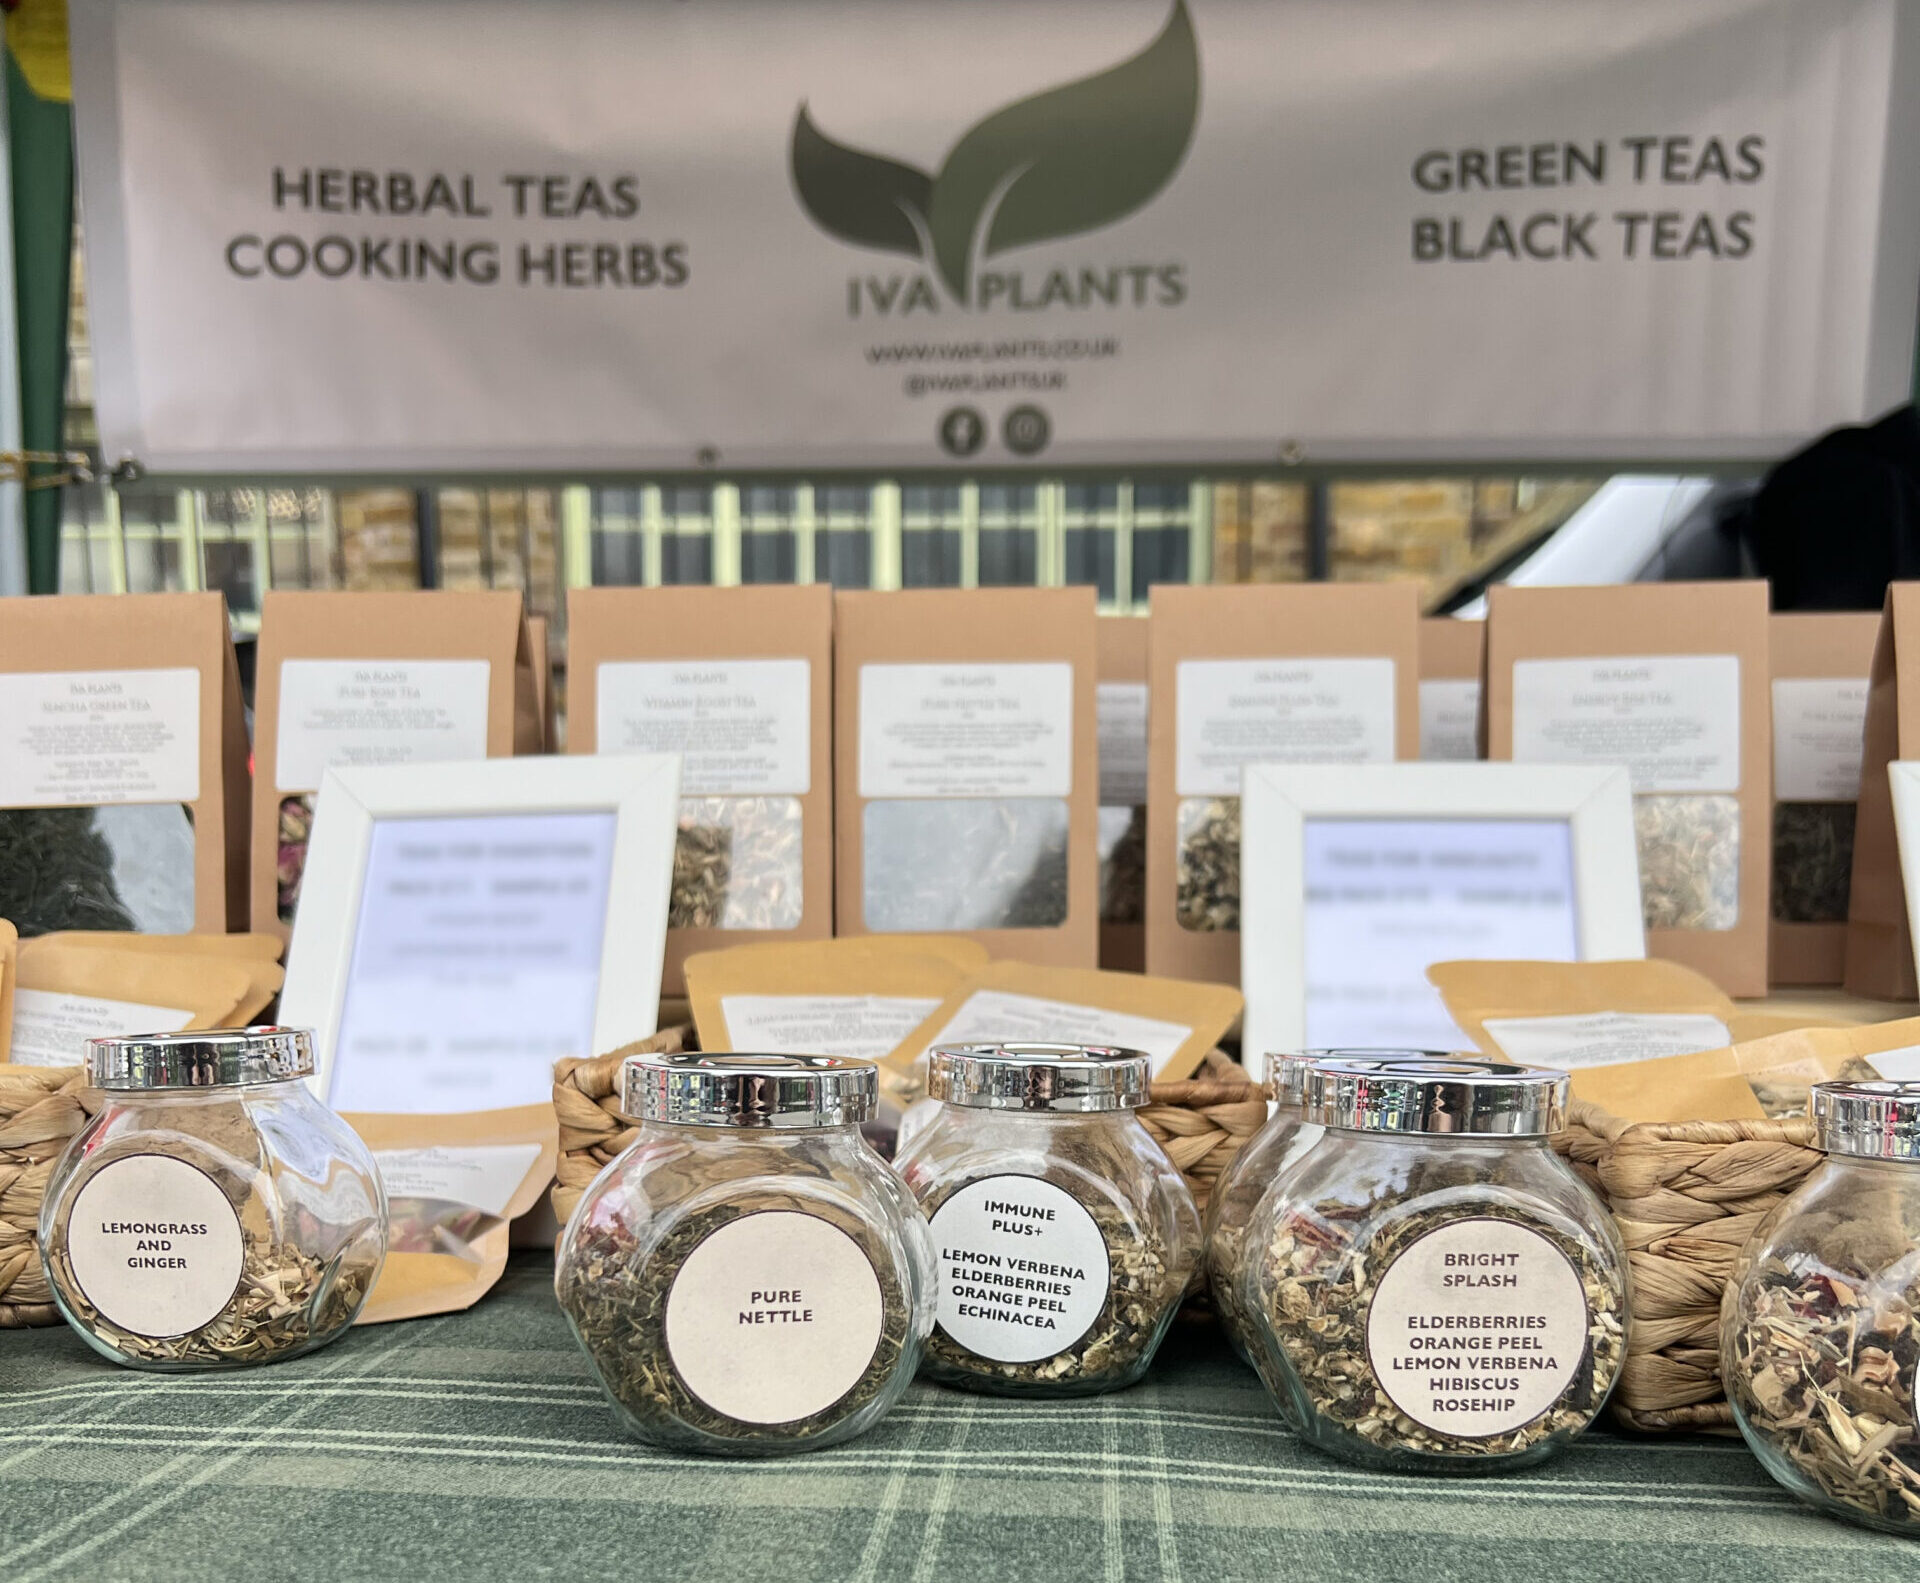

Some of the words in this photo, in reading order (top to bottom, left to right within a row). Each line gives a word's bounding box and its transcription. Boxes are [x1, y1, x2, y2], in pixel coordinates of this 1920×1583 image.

[1411, 141, 1606, 193] GREEN
[1621, 134, 1765, 184] TEAS
[272, 167, 491, 217] HERBAL
[504, 173, 640, 219] TEAS
[1412, 212, 1598, 262] BLACK
[1613, 211, 1754, 261] TEAS
[226, 233, 499, 284] COOKING
[518, 241, 690, 287] HERBS
[847, 273, 940, 318] IVA
[976, 264, 1188, 312] PLANTS
[984, 1200, 1056, 1221] IMMUNE
[102, 1223, 207, 1234] LEMONGRASS
[991, 1219, 1043, 1236] PLUS+
[137, 1240, 171, 1251] AND
[128, 1258, 187, 1268] GINGER
[942, 1248, 1001, 1267] LEMON
[1007, 1258, 1085, 1280] VERBENA
[1445, 1254, 1519, 1266] BRIGHT
[952, 1268, 1071, 1295] ELDERBERRIES
[1443, 1275, 1516, 1287] SPLASH
[752, 1290, 801, 1304] PURE
[953, 1286, 1023, 1305] ORANGE
[1028, 1297, 1066, 1312] PEEL
[739, 1310, 812, 1324] NETTLE
[958, 1303, 1056, 1330] ECHINACEA
[1408, 1316, 1546, 1328] ELDERBERRIES
[1410, 1337, 1492, 1349] ORANGE
[1498, 1337, 1542, 1349] PEEL
[1393, 1357, 1460, 1369] LEMON
[1467, 1357, 1558, 1369] VERBENA
[1430, 1378, 1519, 1390] HIBISCUS
[1433, 1399, 1515, 1411] ROSEHIP
